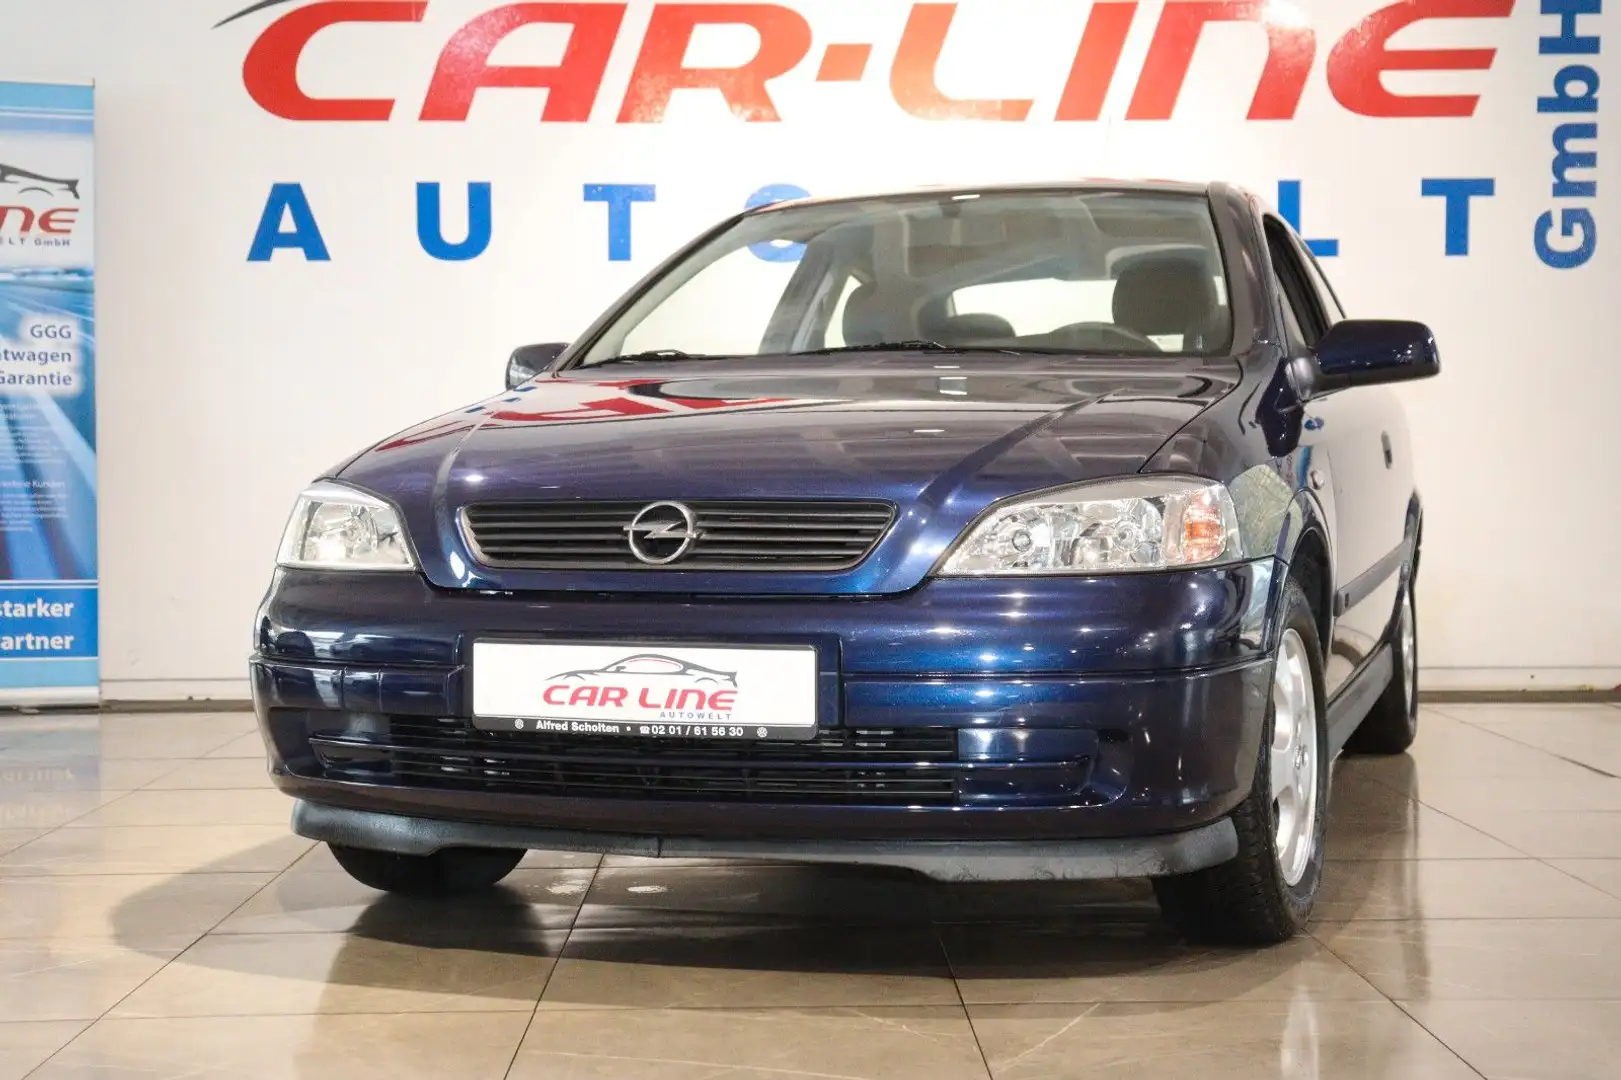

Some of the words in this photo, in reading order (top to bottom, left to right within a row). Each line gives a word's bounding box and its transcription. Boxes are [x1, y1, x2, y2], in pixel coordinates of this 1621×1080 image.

[1534, 0, 1602, 269] GmbH
[30, 324, 71, 339] GGG
[0, 348, 72, 366] twagen
[543, 684, 629, 707] CAR
[638, 687, 739, 711] LINE
[659, 711, 732, 720] AUTOWELT
[536, 720, 569, 731] Alfred
[571, 721, 620, 733] Scholten
[651, 725, 666, 735] 02
[668, 725, 682, 735] 01
[693, 726, 708, 736] 61
[728, 726, 744, 737] 30
